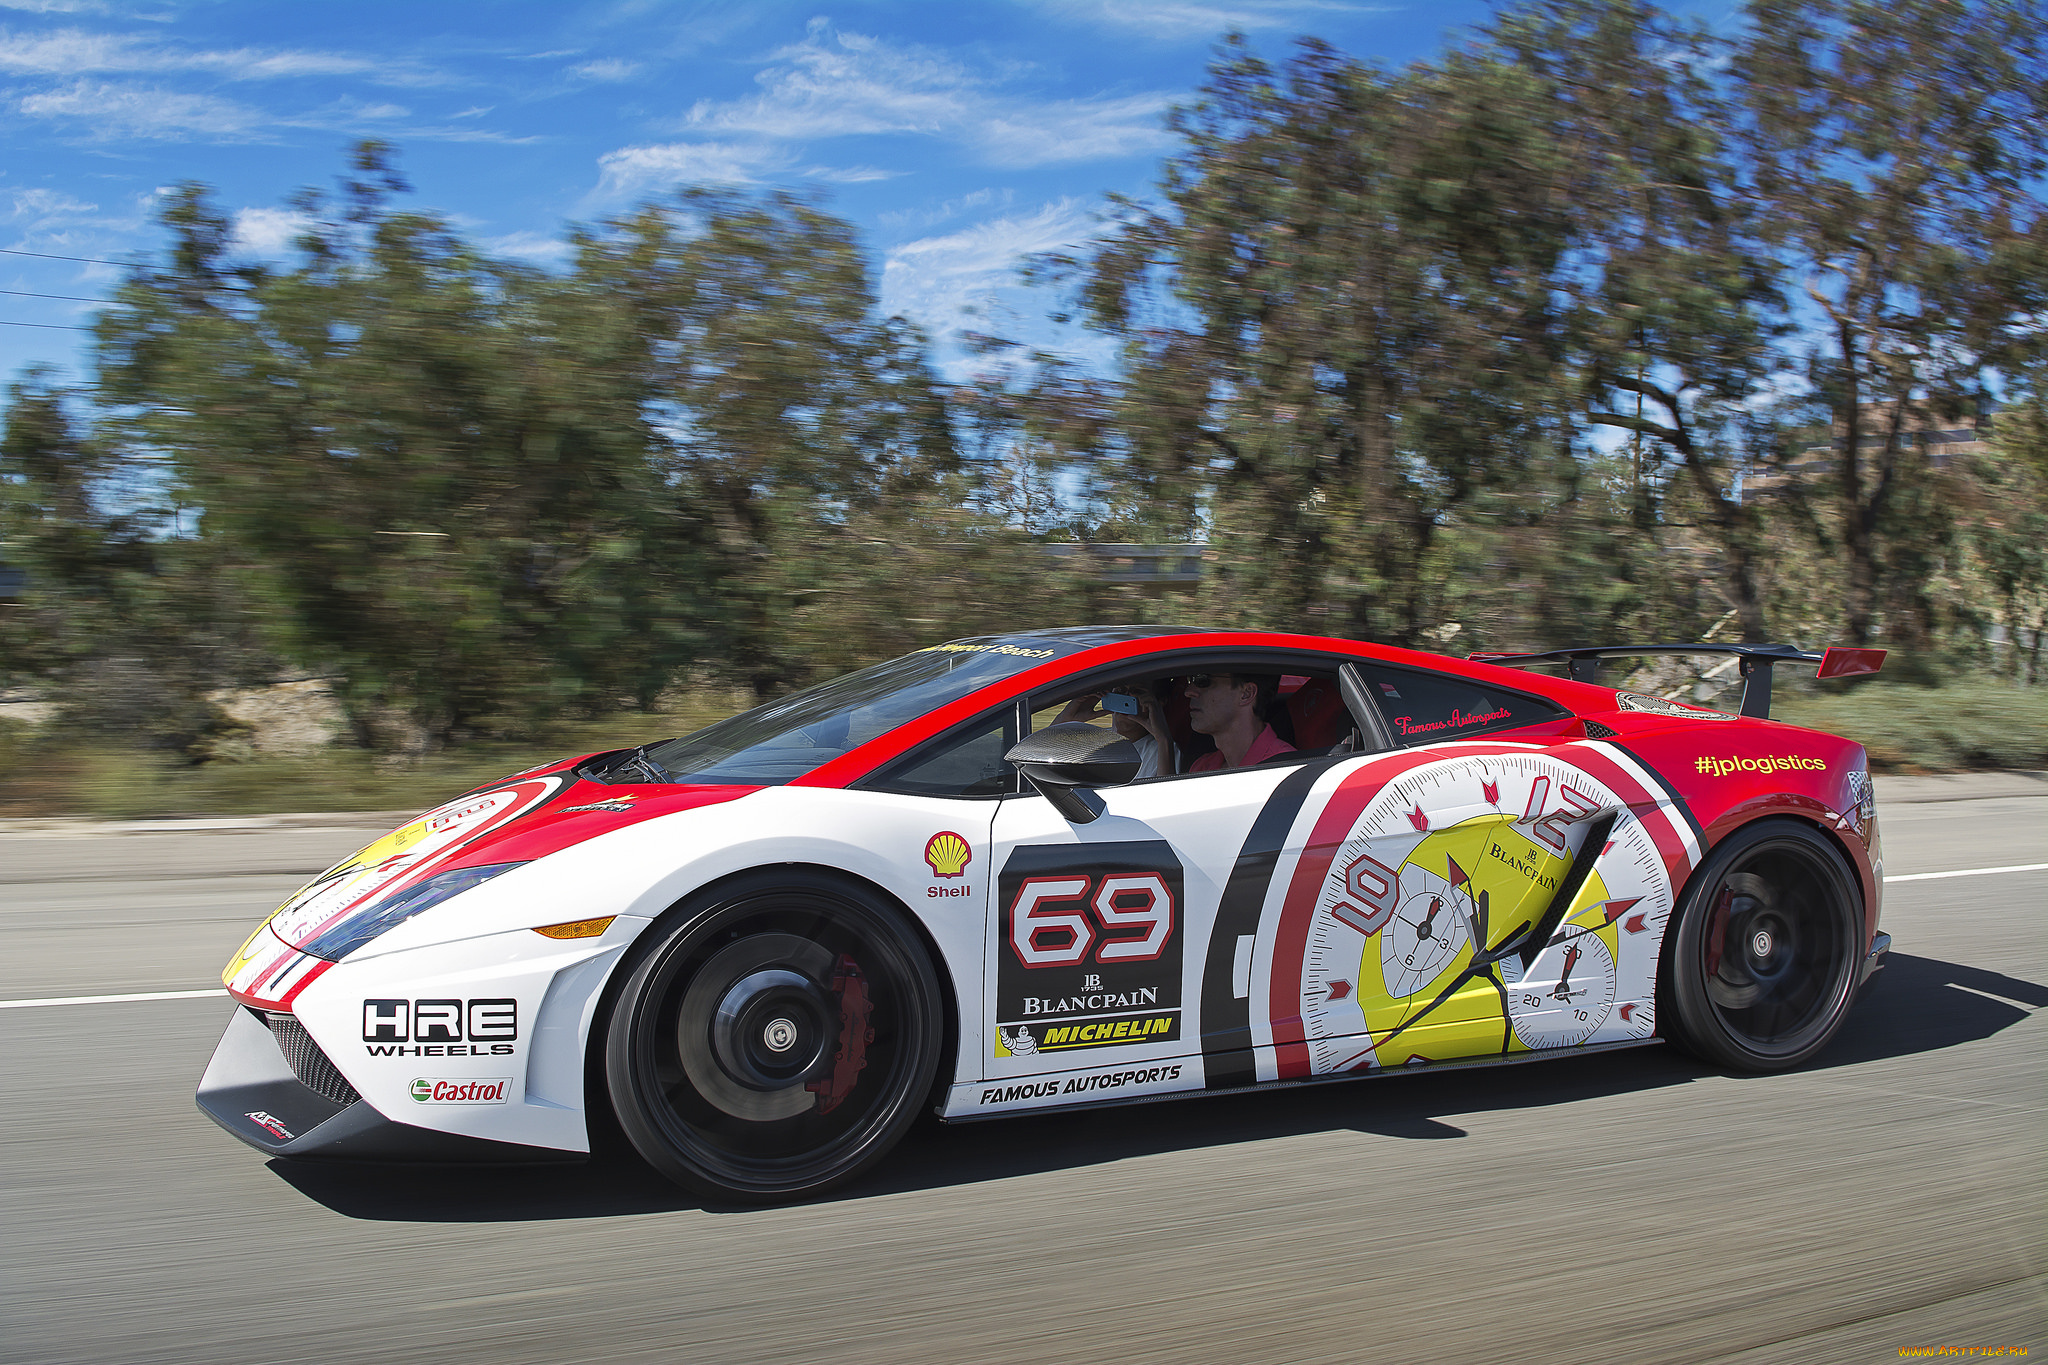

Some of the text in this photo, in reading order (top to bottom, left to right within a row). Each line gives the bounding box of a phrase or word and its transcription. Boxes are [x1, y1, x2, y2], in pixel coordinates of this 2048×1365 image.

[990, 645, 1055, 659] Beach
[1394, 708, 1512, 736] Famous Autosports
[1694, 754, 1827, 777] #jplogistics
[1516, 775, 1601, 851] 12
[927, 885, 971, 898] Shell
[1331, 854, 1400, 938] 9
[1009, 871, 1174, 970] 69
[1439, 938, 1450, 950] 3
[1404, 953, 1416, 966] 6
[1022, 987, 1158, 1016] BLANCPAIN
[1522, 993, 1541, 1008] 20
[363, 999, 517, 1042] HRE
[1573, 1008, 1589, 1022] 10
[1043, 1017, 1173, 1045] MICHELIN
[366, 1043, 515, 1057] WHEELS
[433, 1080, 505, 1101] Castrol
[980, 1064, 1183, 1105] FAMOUS AUTOSPORTS
